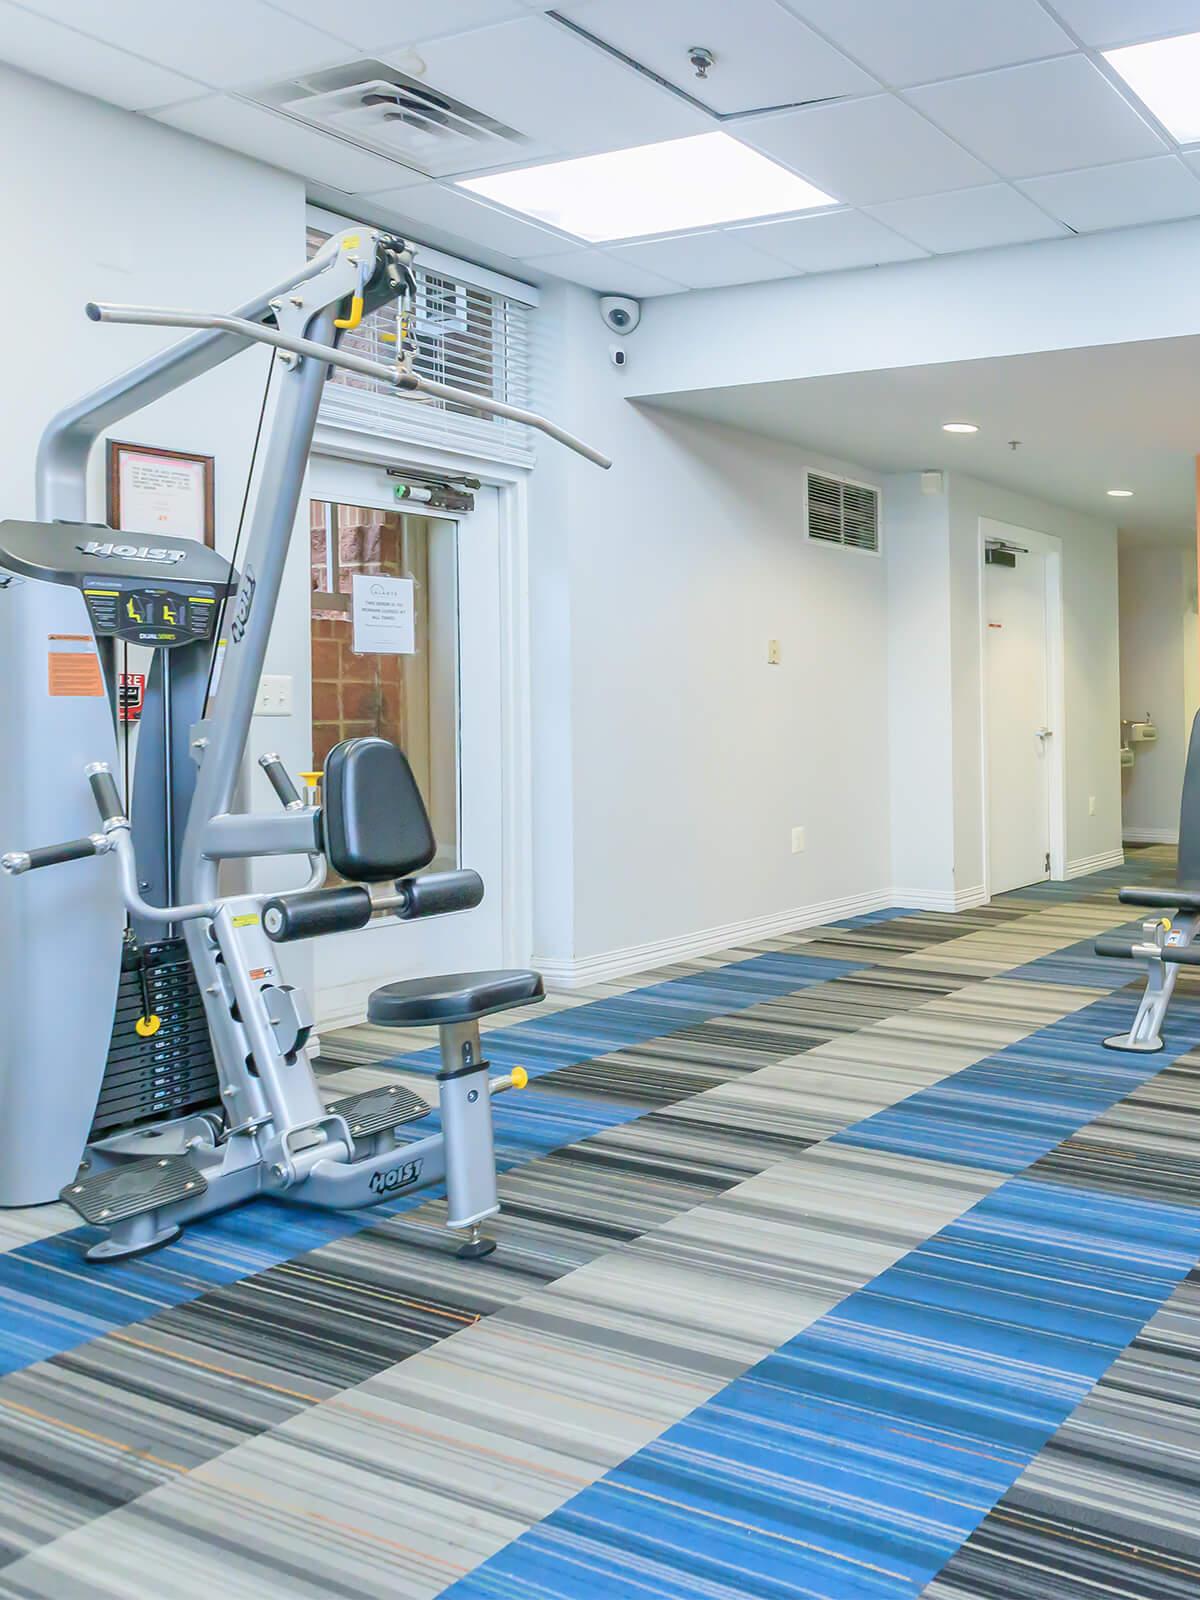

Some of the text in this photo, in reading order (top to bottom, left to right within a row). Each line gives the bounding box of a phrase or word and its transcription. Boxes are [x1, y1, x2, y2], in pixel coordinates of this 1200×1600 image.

[83, 541, 187, 563] HOIST
[119, 674, 142, 686] IRE
[368, 1157, 424, 1194] HOIST
